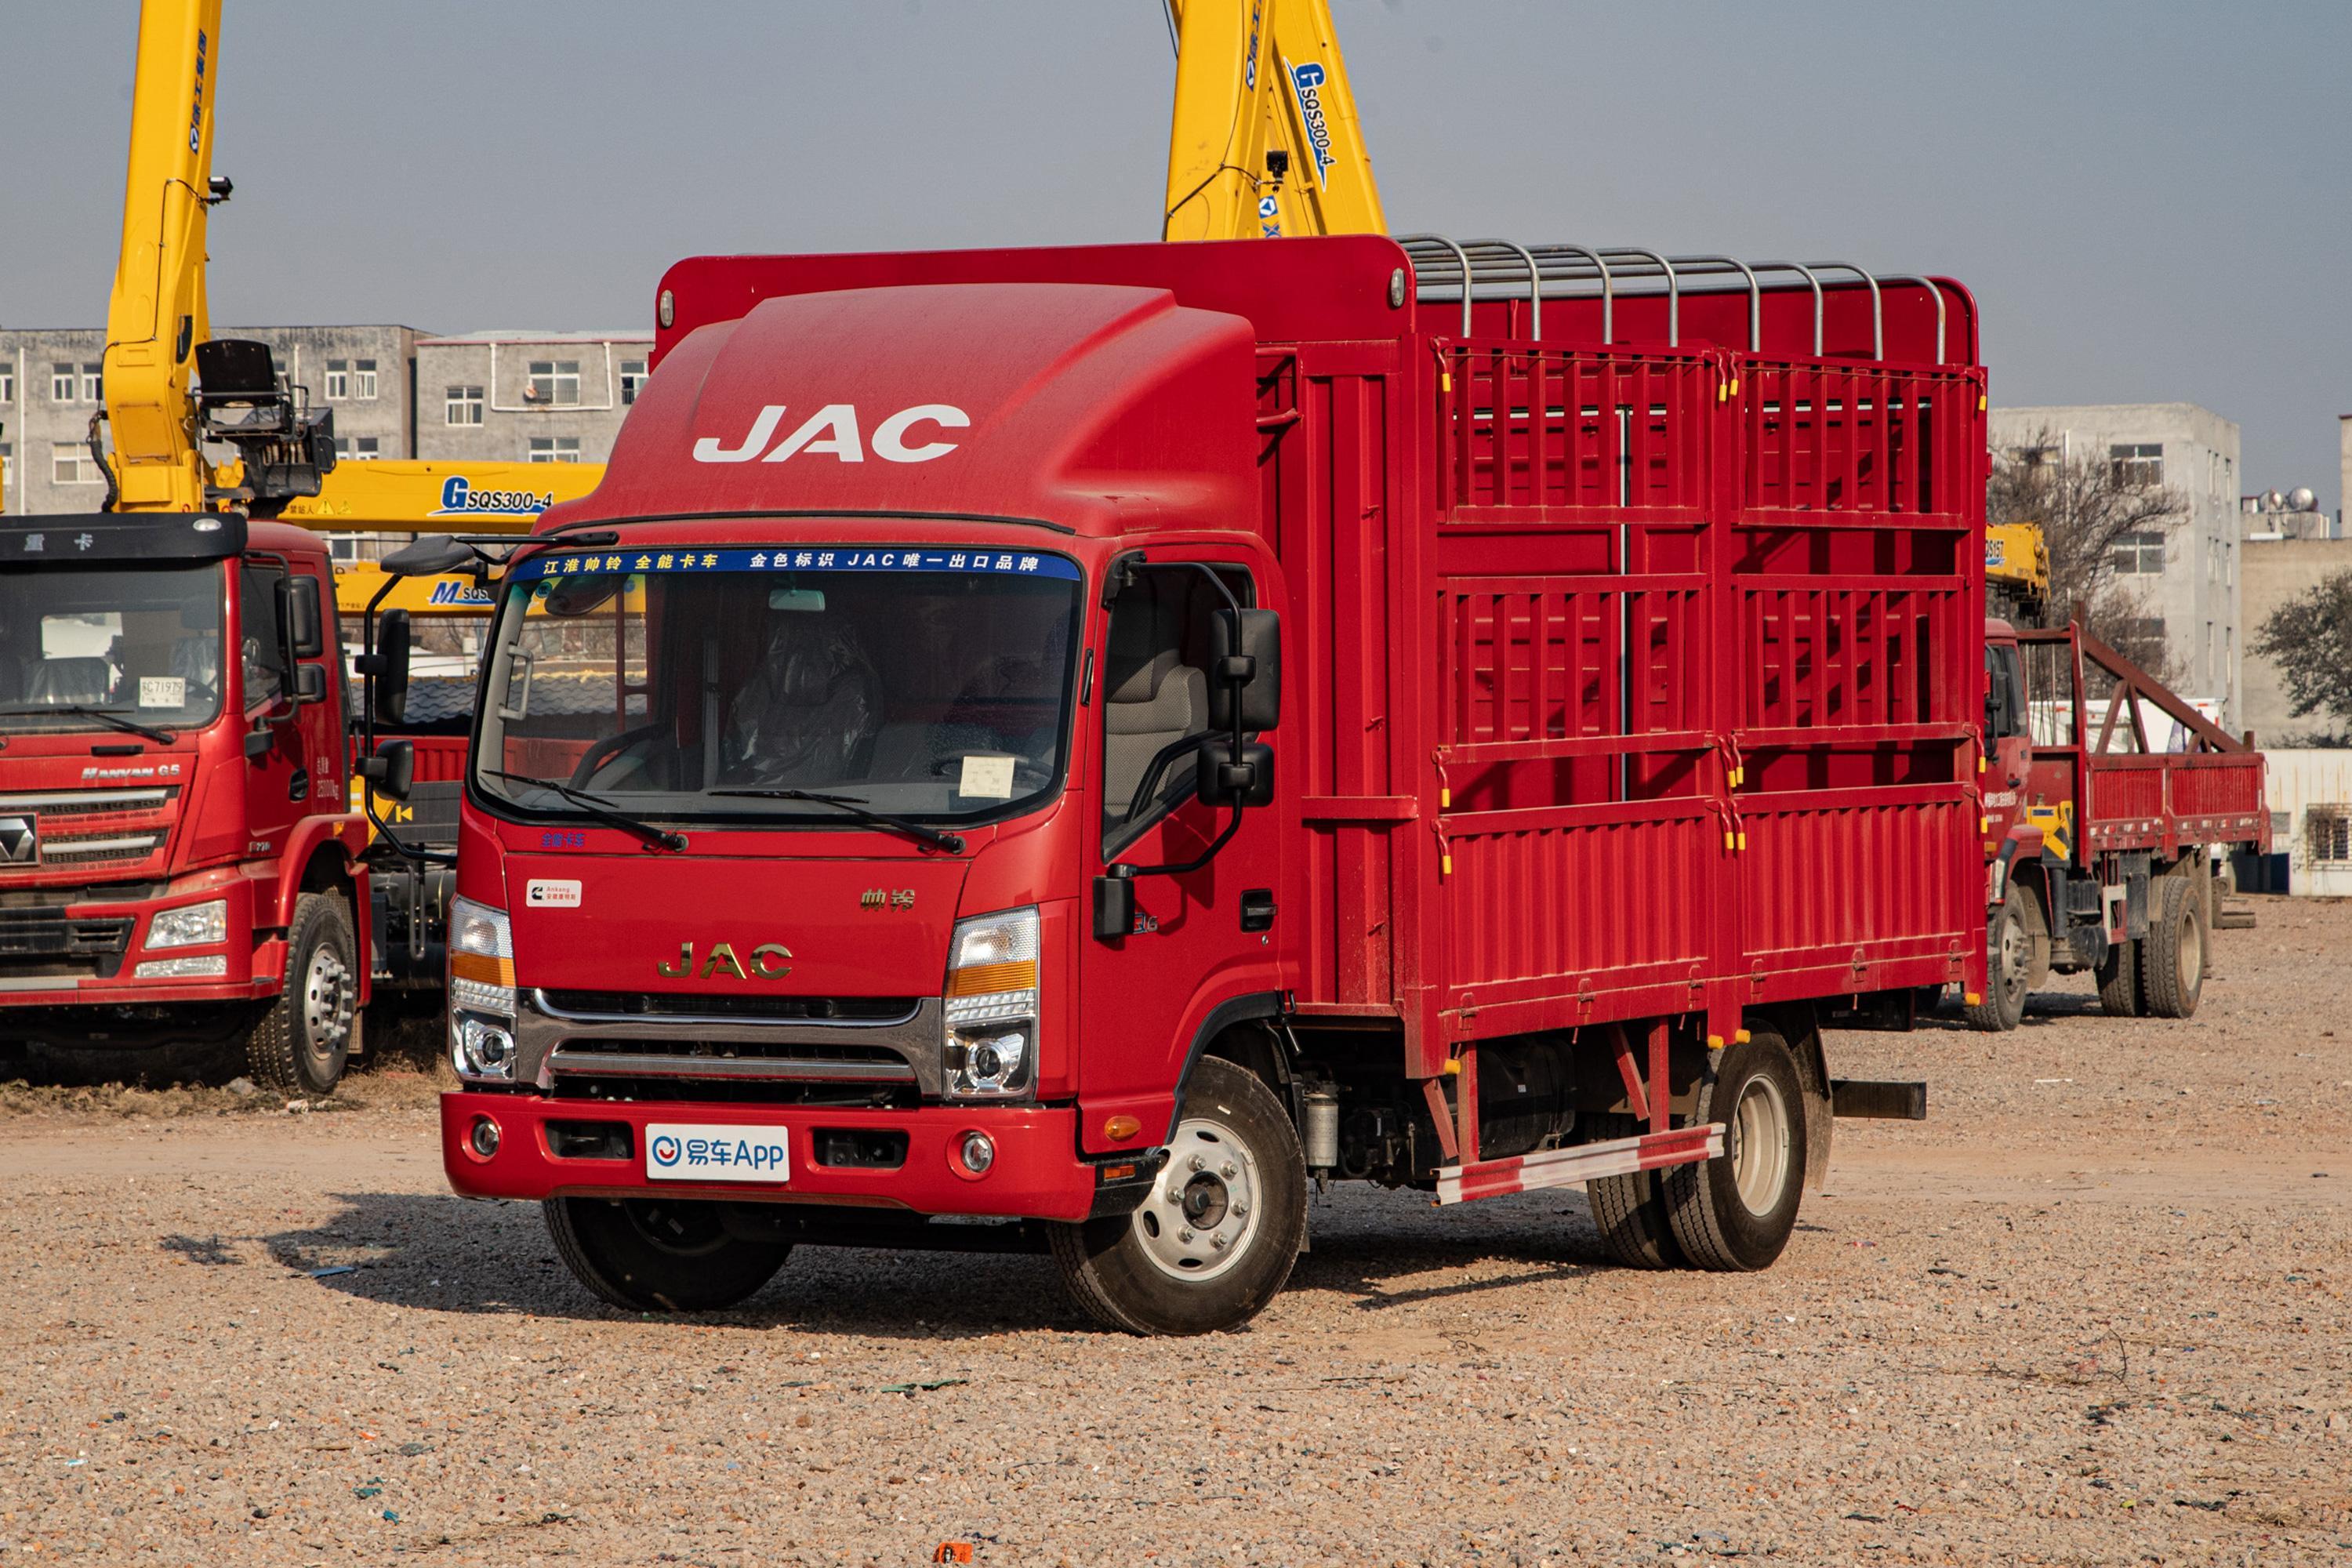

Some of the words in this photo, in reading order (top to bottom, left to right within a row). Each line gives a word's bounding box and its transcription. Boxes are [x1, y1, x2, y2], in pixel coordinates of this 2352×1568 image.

[1295, 63, 1336, 165] GSQS300-4
[693, 405, 971, 463] JAC
[442, 476, 553, 509] GSQS300-4
[543, 556, 622, 574] 江淮帅铃
[634, 554, 718, 569] 全能卡车
[750, 553, 835, 568] 金色标识
[158, 764, 180, 776] G5
[657, 941, 793, 980] JAC
